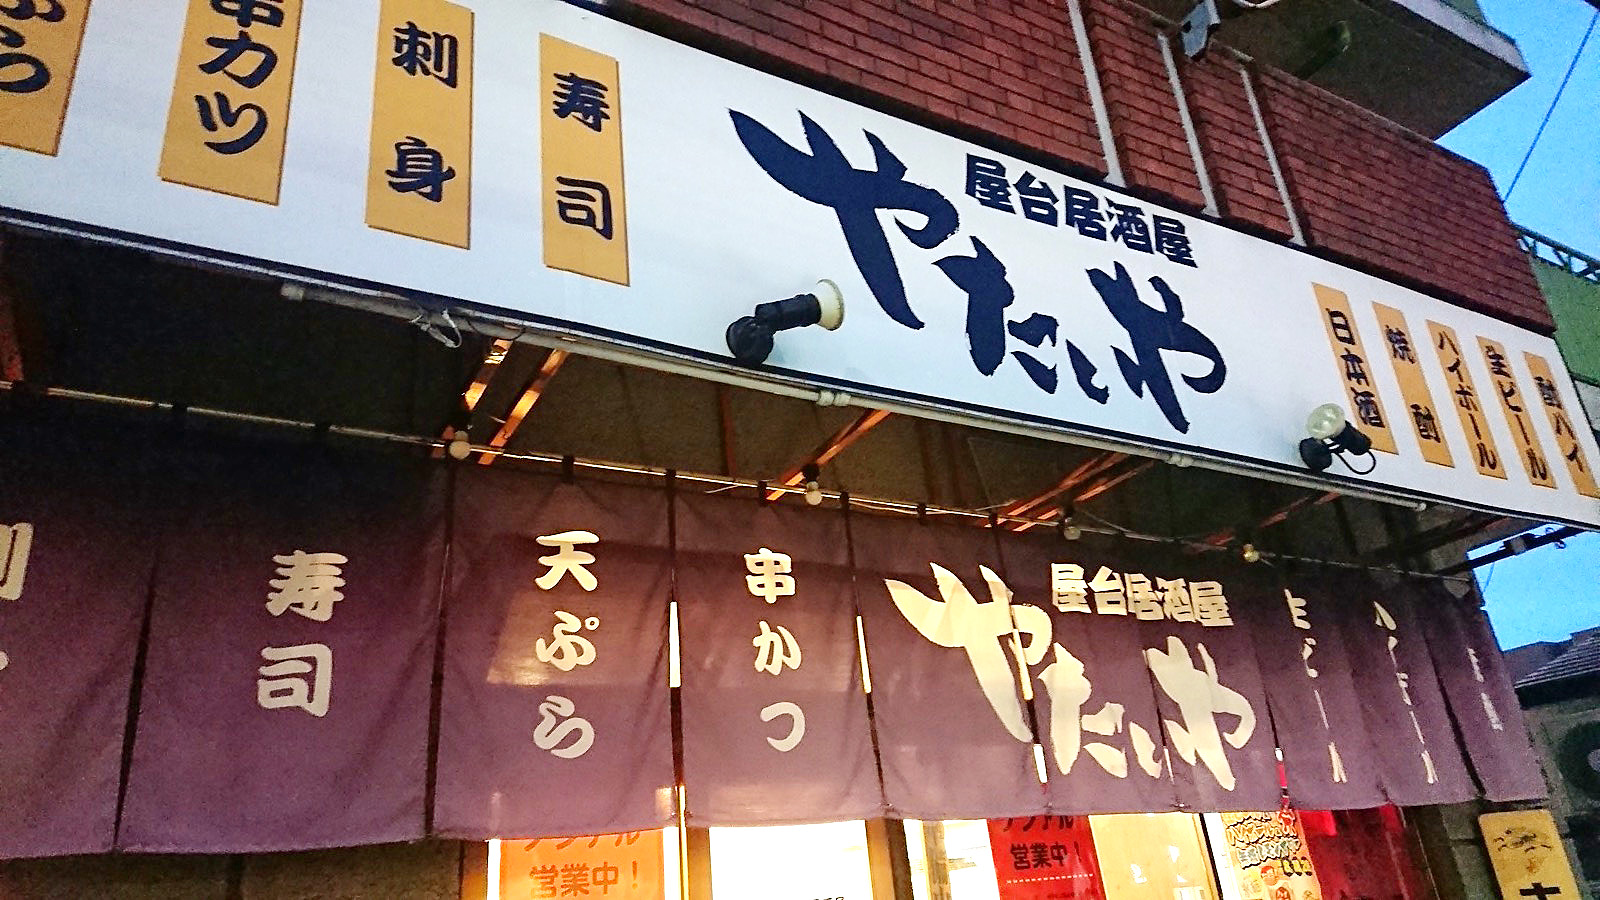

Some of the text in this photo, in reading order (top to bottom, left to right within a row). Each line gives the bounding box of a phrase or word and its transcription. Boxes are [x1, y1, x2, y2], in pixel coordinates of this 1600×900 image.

[385, 20, 457, 202] 刺身
[552, 72, 613, 240] 寿司
[728, 108, 1227, 435] やたいや
[966, 152, 1198, 268] 屋台居酒屋
[1325, 307, 1386, 428] 日本酒
[1438, 330, 1497, 471] ハイボール
[1485, 344, 1548, 481] 生ビール
[257, 549, 349, 717] 寿司
[533, 529, 600, 759] 天ぷら
[743, 547, 806, 752] 串かつ
[884, 561, 1257, 792] やたいや
[1050, 562, 1235, 628] 屋台居酒屋
